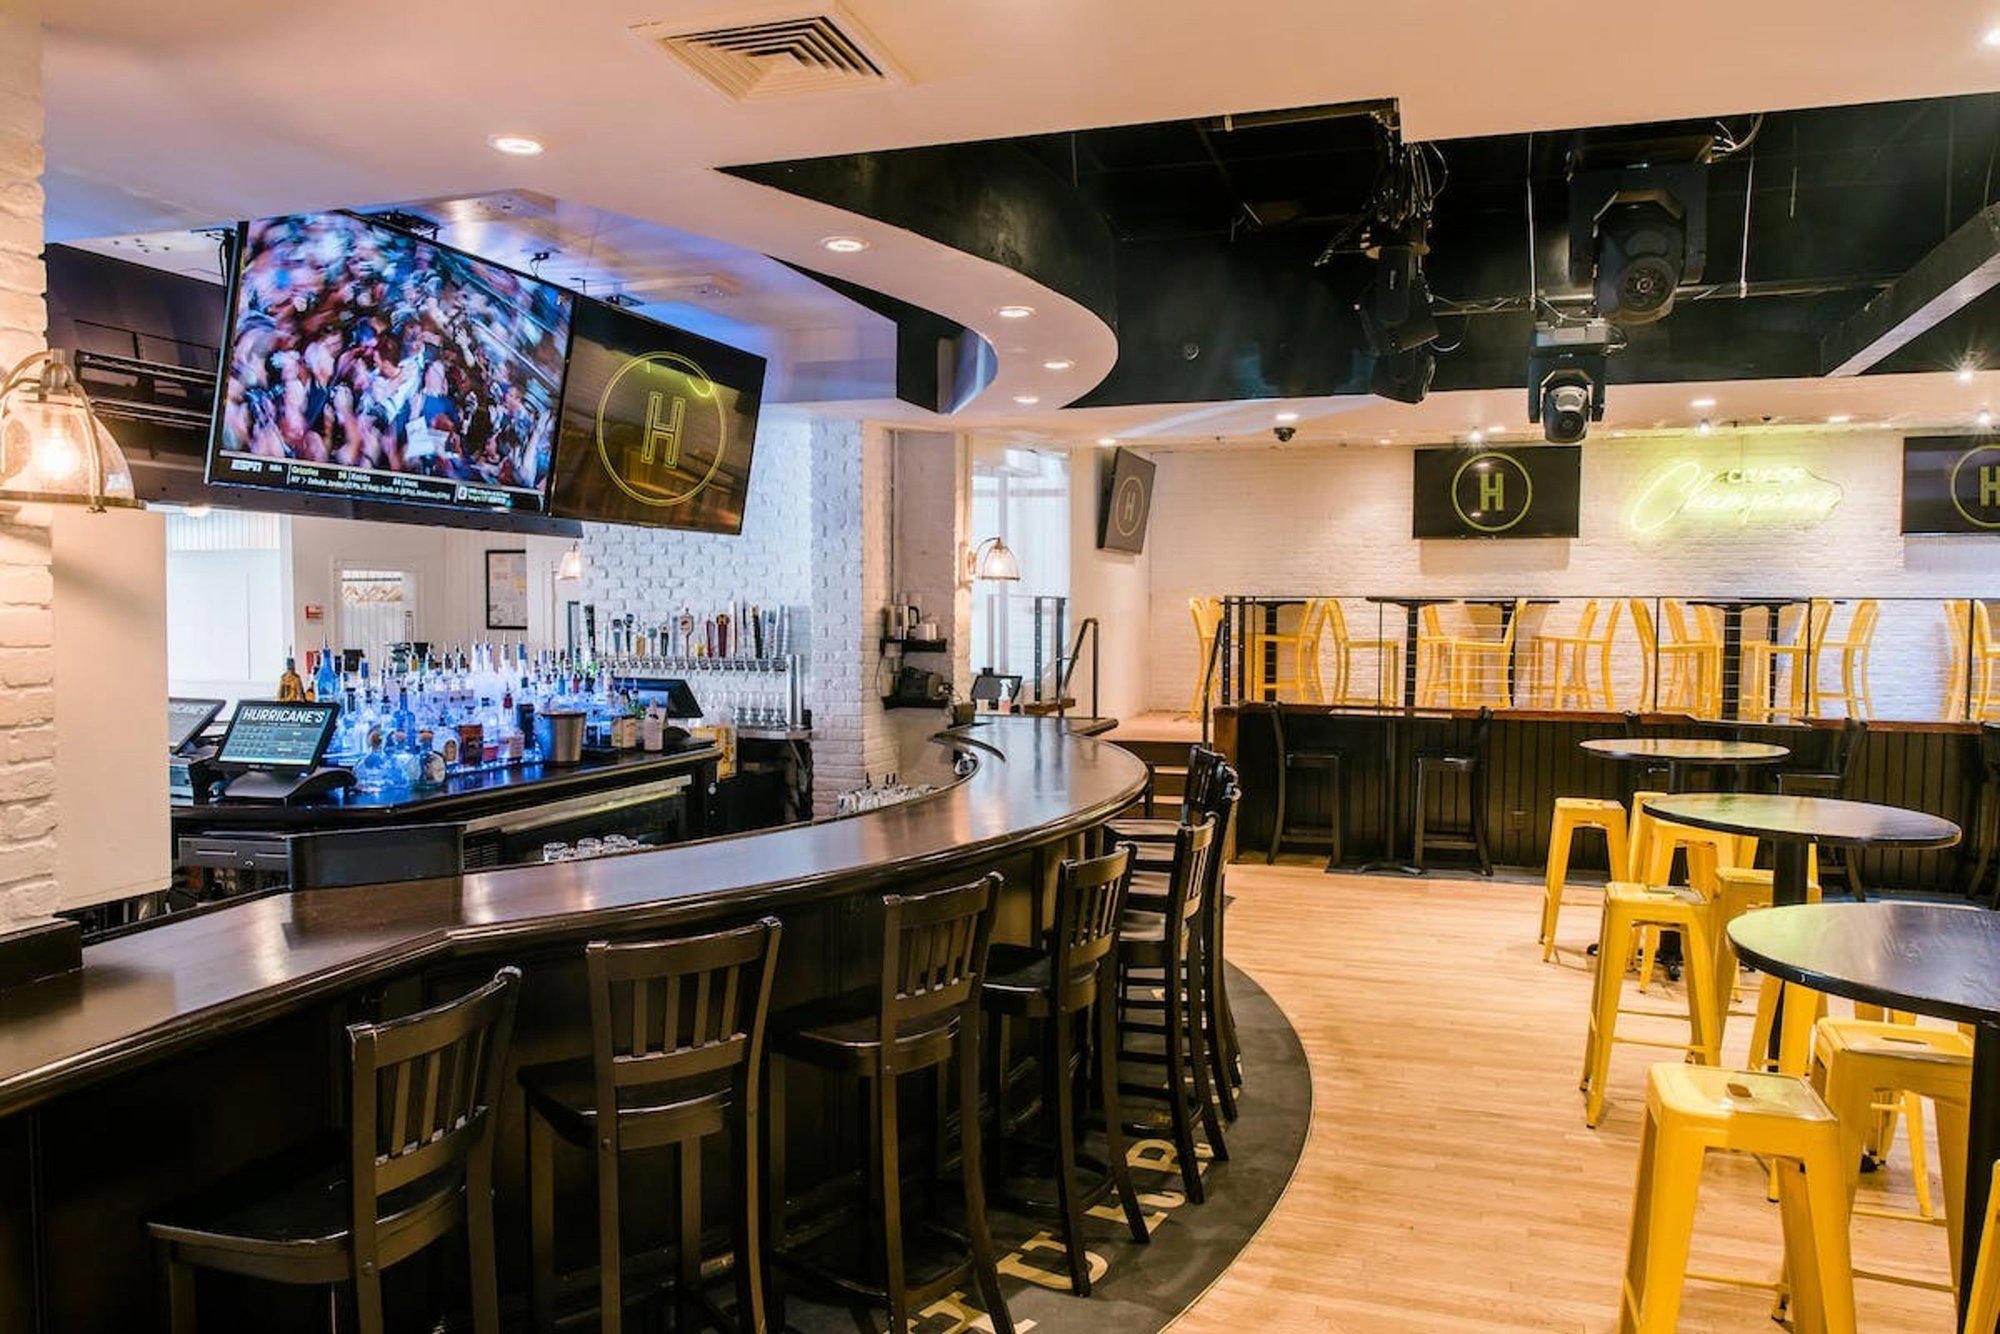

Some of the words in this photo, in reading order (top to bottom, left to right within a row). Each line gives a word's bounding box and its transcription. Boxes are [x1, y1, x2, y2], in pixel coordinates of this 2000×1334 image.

[641, 391, 685, 469] H
[230, 459, 262, 473] ESPN
[1480, 472, 1504, 512] H
[1980, 465, 2000, 507] H
[1124, 491, 1136, 521] H
[242, 707, 326, 724] HURRICANE'S
